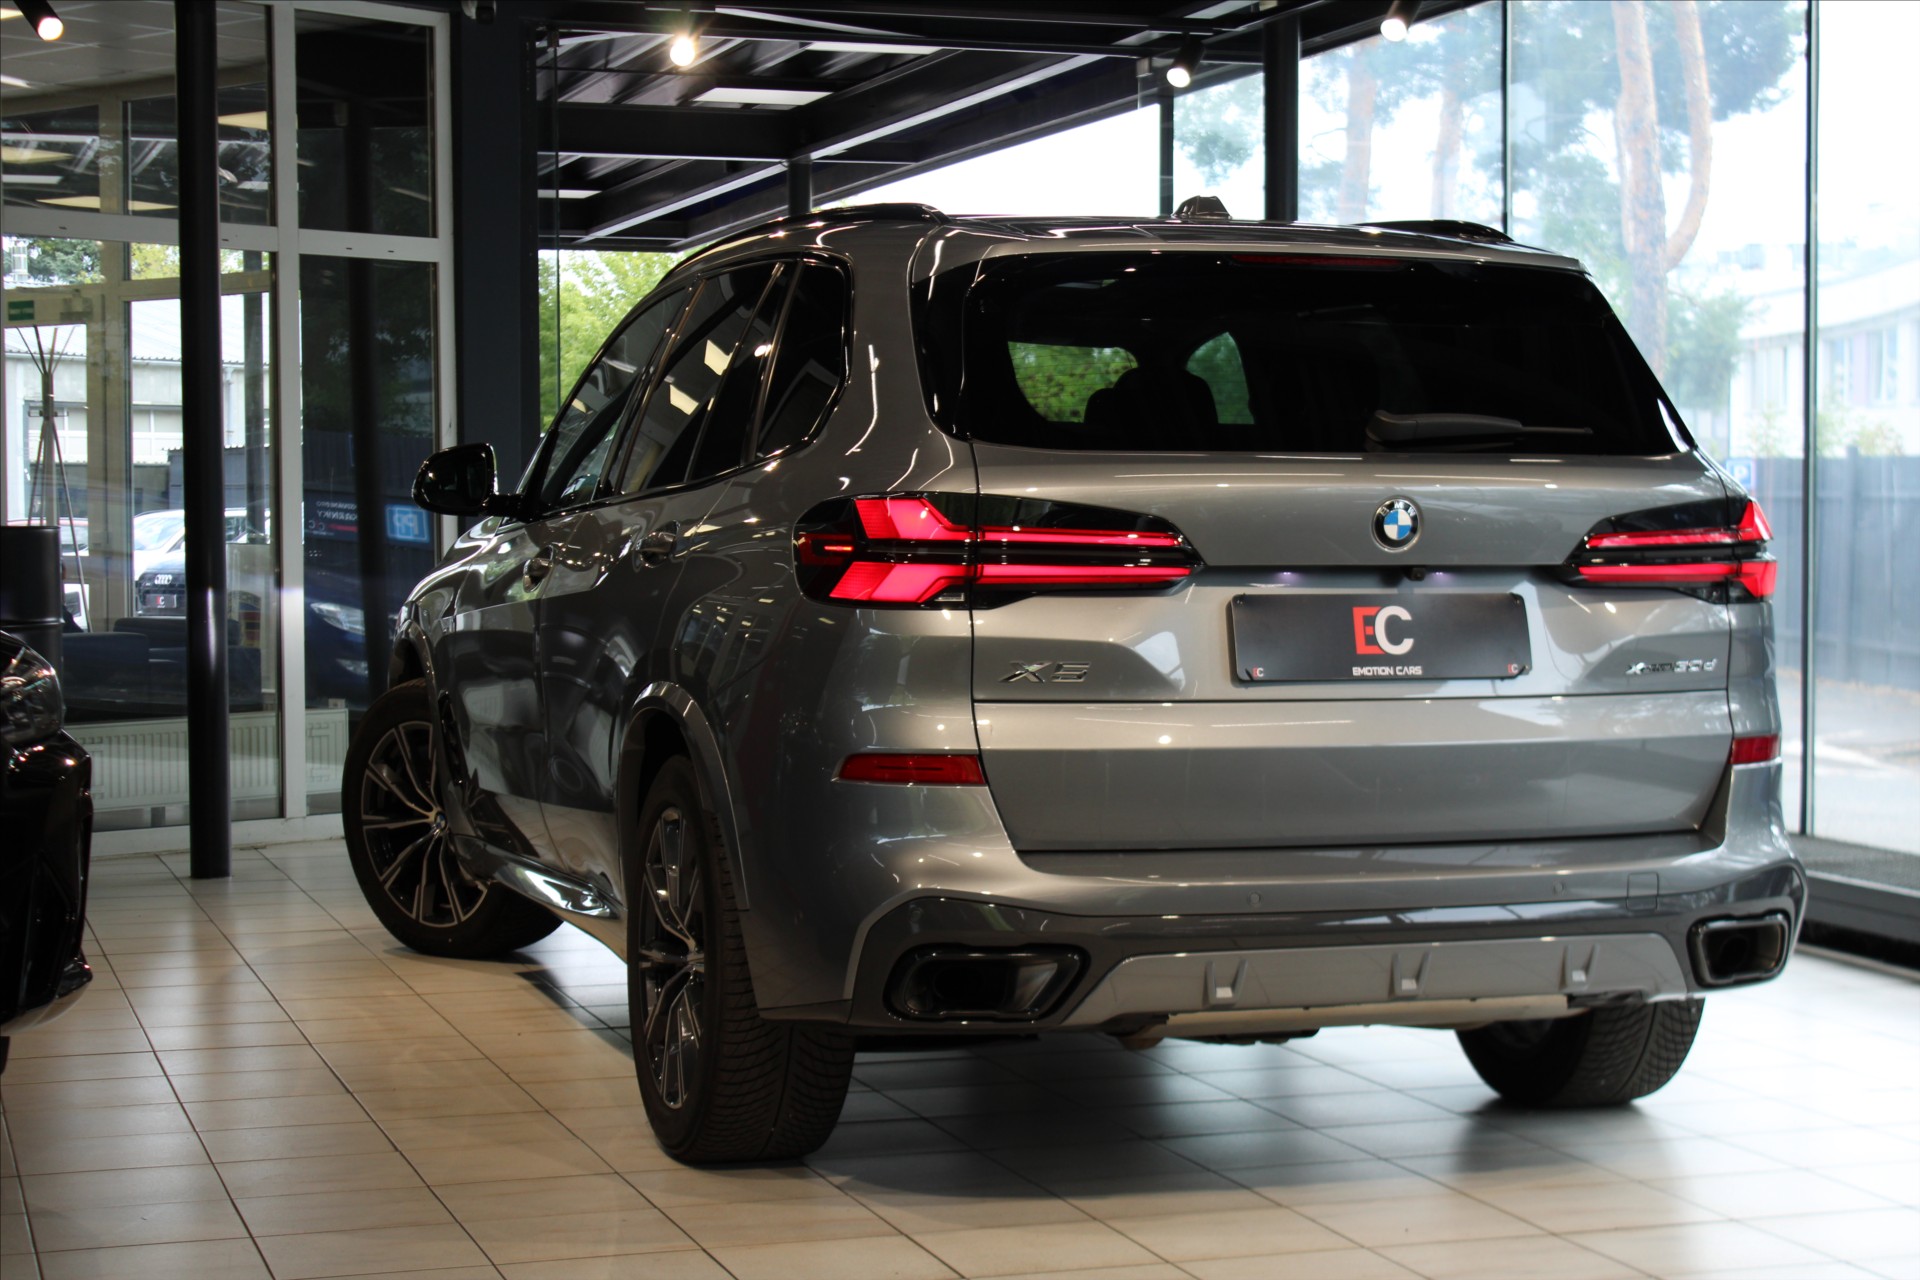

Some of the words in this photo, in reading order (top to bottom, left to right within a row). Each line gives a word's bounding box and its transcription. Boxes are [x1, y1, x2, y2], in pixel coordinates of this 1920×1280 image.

[1734, 464, 1748, 481] P
[1379, 500, 1417, 517] BMW
[1352, 605, 1414, 655] EC
[998, 660, 1091, 683] X5
[1352, 666, 1394, 676] EMOTION
[1395, 665, 1422, 675] CARS
